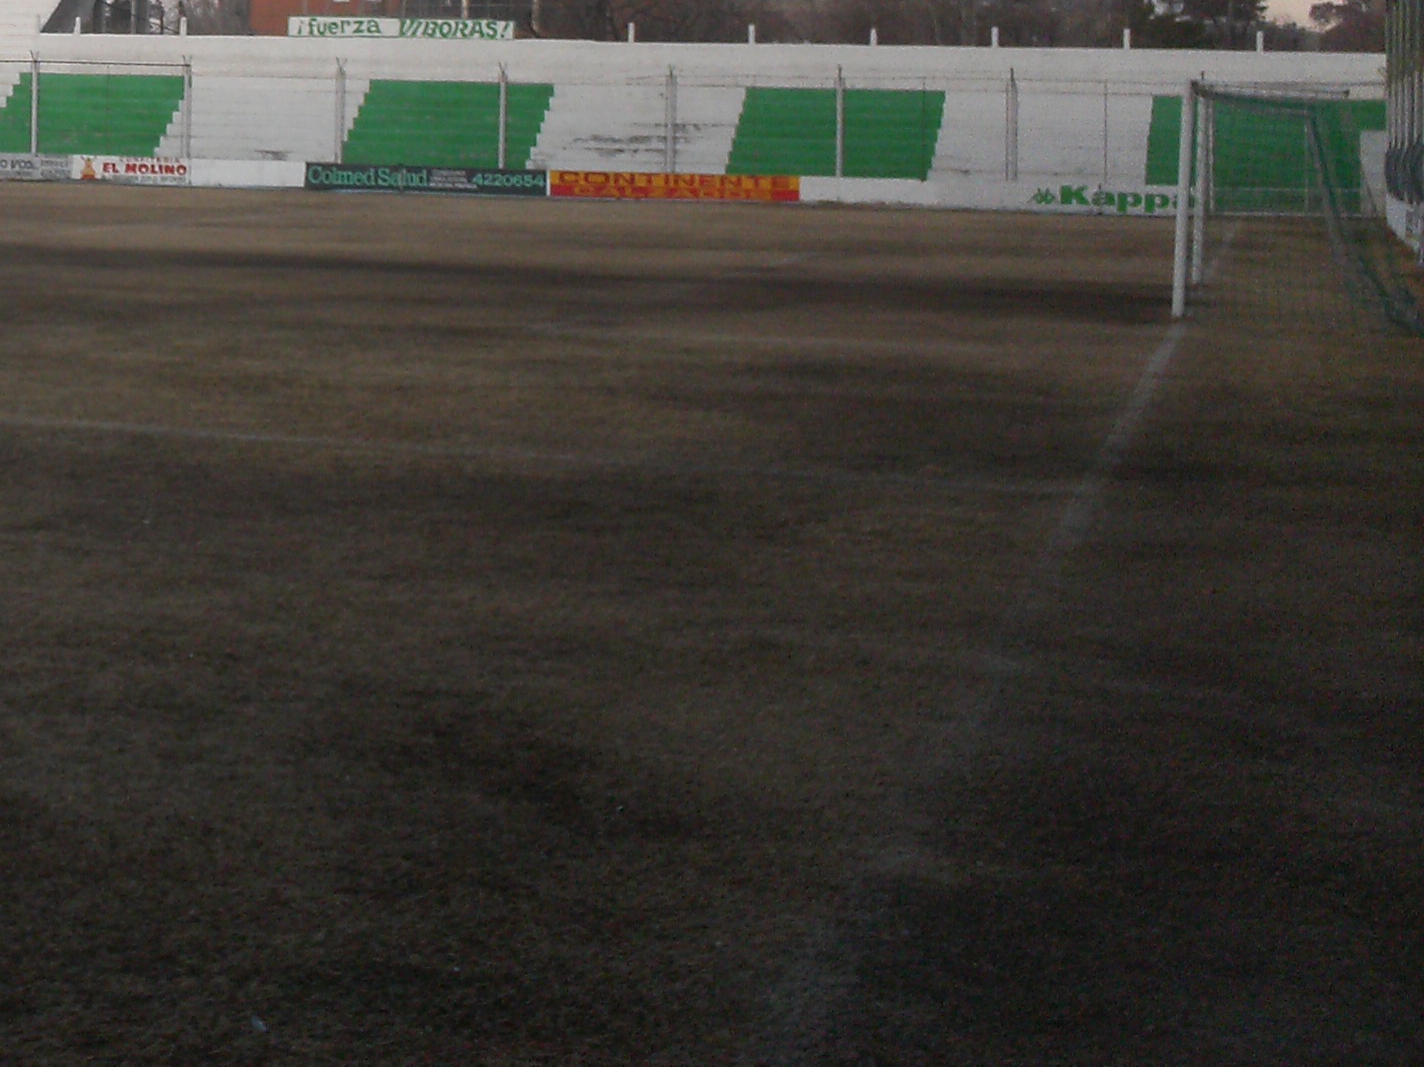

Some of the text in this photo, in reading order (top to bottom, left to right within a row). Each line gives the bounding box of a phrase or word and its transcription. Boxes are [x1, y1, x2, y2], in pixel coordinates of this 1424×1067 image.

[102, 162, 188, 176] EL MOLINO
[378, 168, 428, 186] Salud
